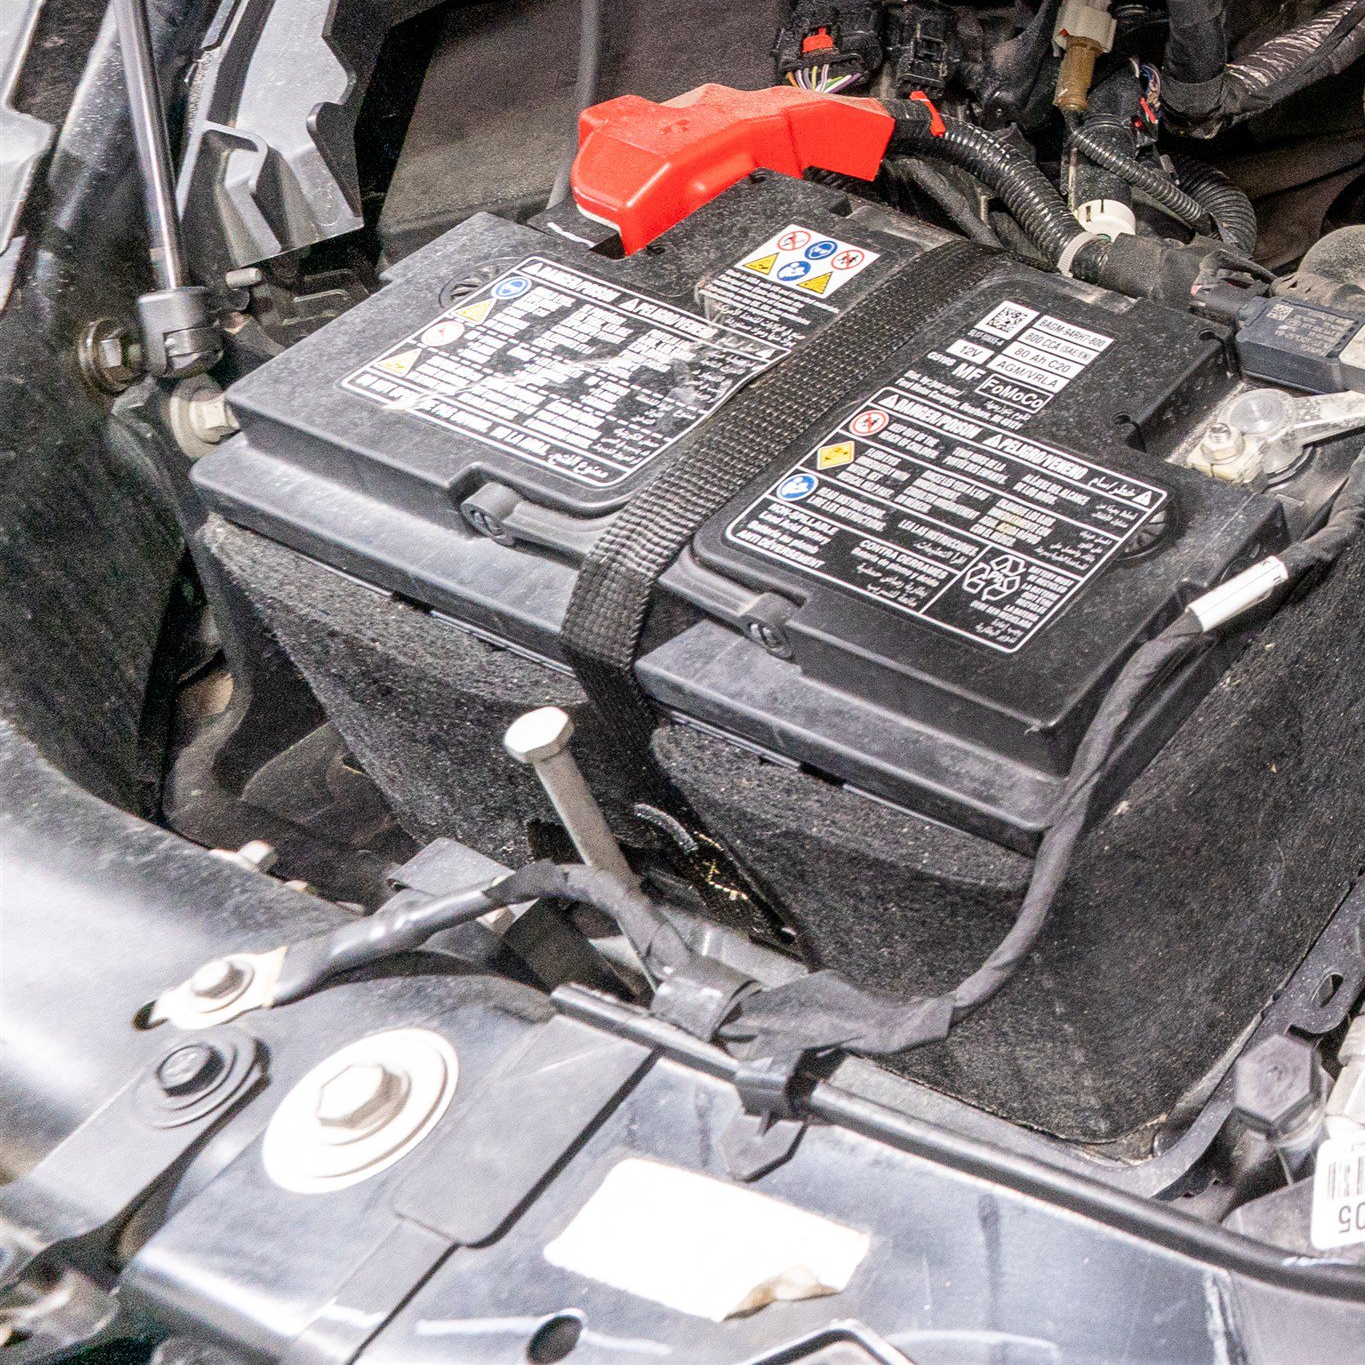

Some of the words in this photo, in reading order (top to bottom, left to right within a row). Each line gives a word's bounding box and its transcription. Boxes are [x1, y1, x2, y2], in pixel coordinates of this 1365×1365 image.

[1024, 332, 1044, 343] 800
[1041, 338, 1062, 350] CCA
[1059, 345, 1092, 360] (SAE/EN)
[1038, 319, 1106, 347] BAGM-94RH7-800
[958, 345, 981, 357] 12V
[995, 360, 1059, 387] AGM/VRLA
[1013, 347, 1031, 357] 80
[1029, 353, 1048, 364] Ah
[1046, 359, 1071, 372] C20
[950, 362, 986, 382] MF
[981, 378, 1046, 409] FoMoCo
[892, 398, 982, 439] DANGER/POISON
[996, 438, 1089, 480] PELIGRO/VENENO
[768, 502, 839, 535] NON-SPILLABLE
[736, 528, 762, 543] ANTI
[859, 539, 899, 559] CONTRA
[895, 554, 948, 579] DERRAMES
[986, 570, 1006, 583] Pb
